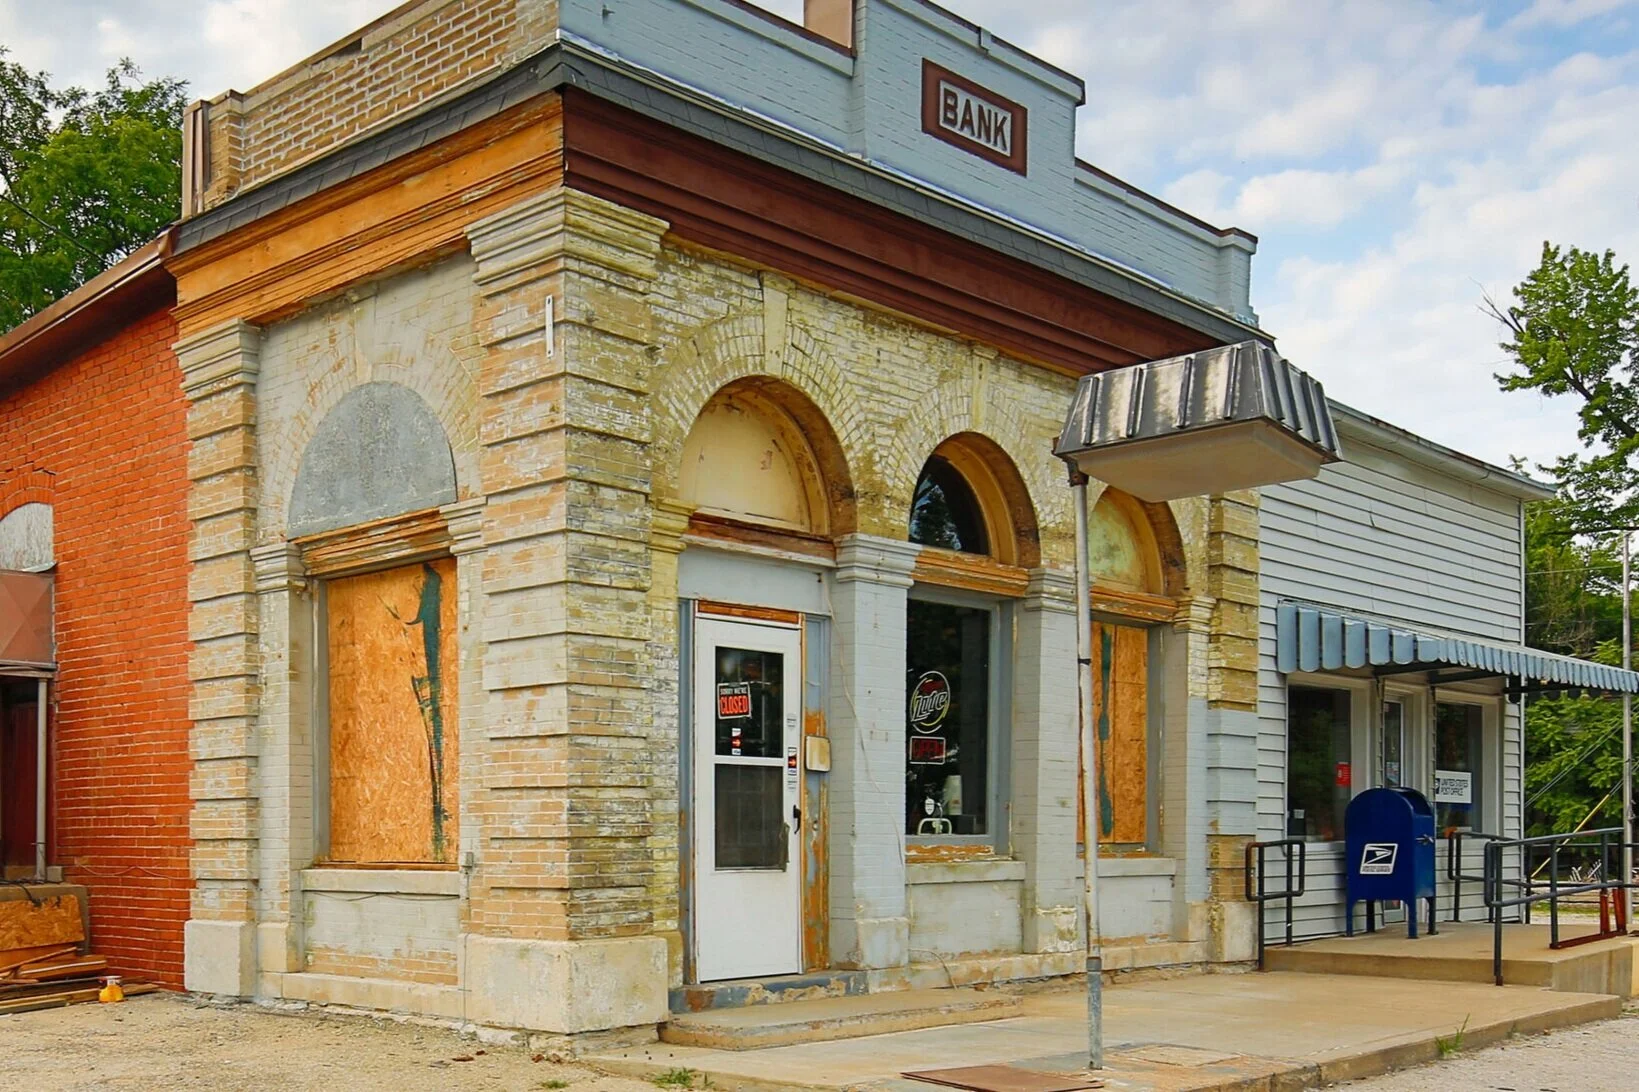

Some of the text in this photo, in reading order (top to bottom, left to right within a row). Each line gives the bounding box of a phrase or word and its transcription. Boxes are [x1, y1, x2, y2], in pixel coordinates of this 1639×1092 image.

[943, 87, 1007, 151] BANK
[720, 695, 748, 714] CLOSED
[911, 691, 948, 722] Lite
